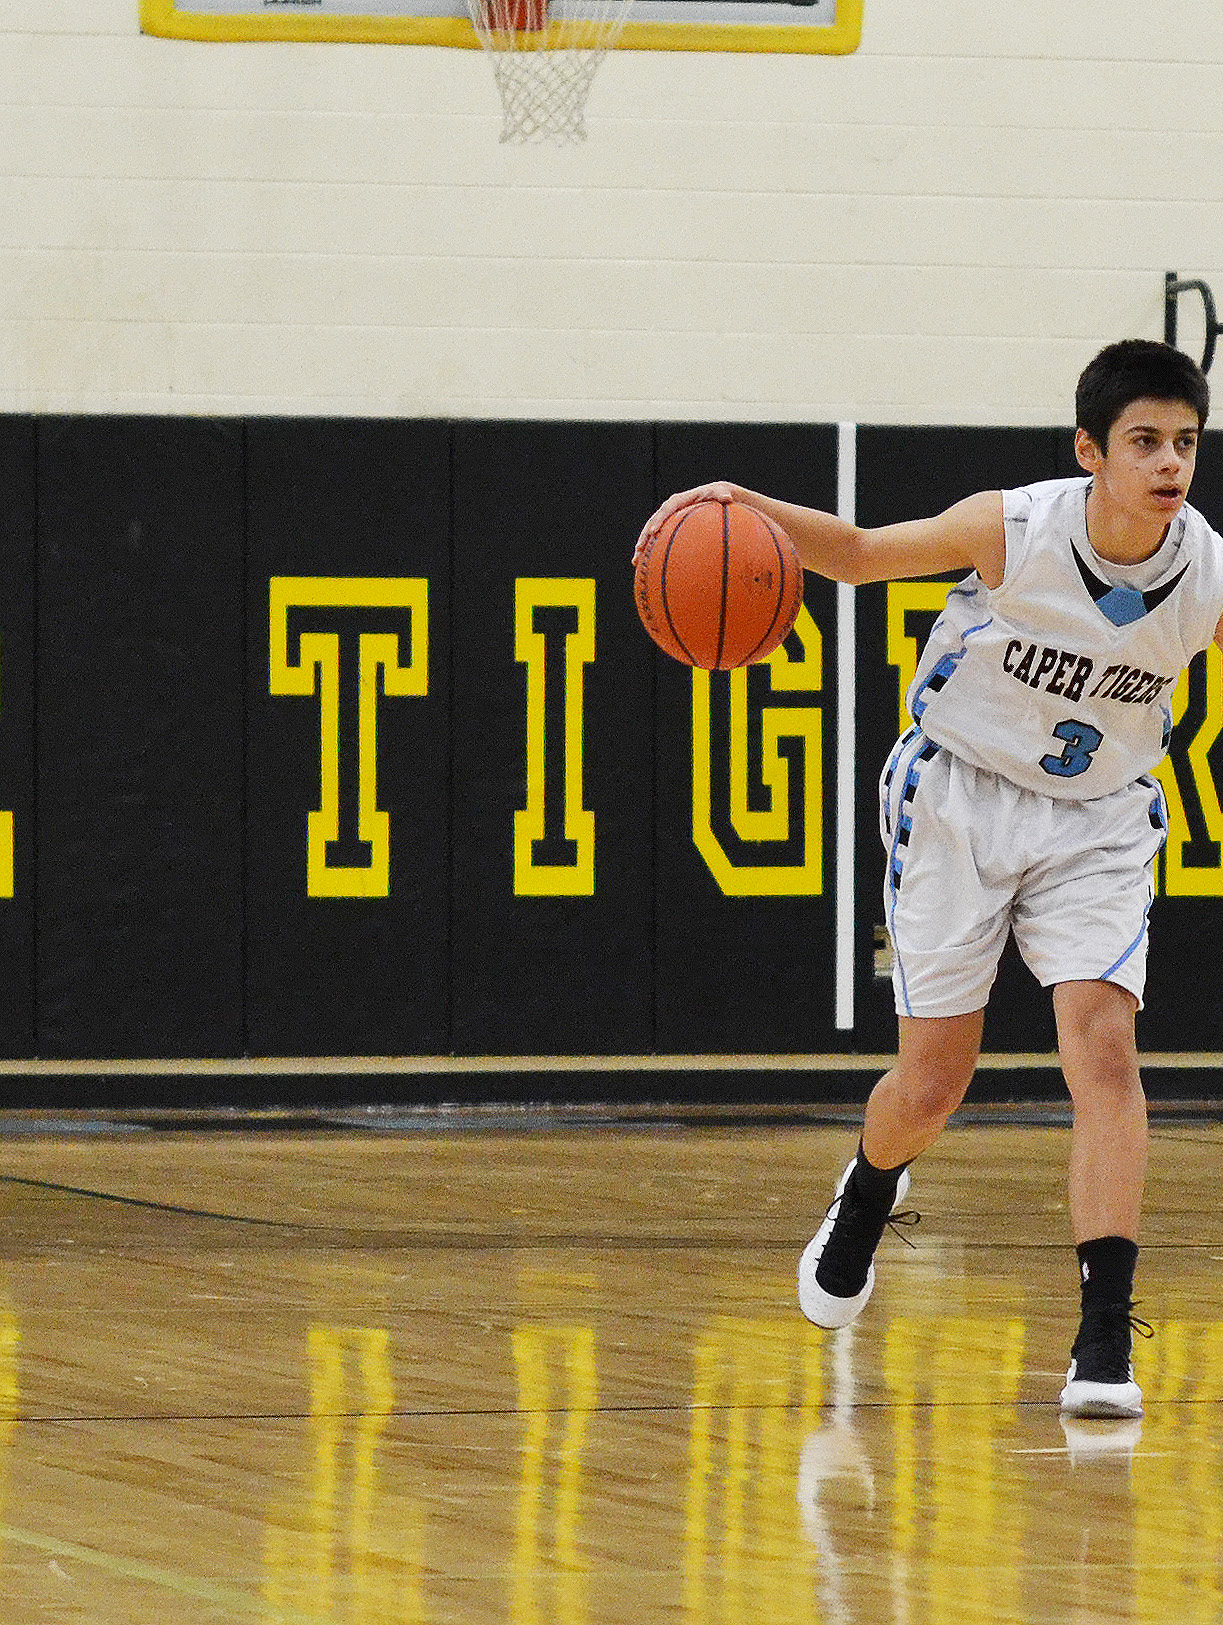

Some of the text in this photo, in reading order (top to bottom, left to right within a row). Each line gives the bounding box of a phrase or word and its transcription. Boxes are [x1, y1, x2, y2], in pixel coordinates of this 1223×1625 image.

[1003, 640, 1175, 704] CAPER TIGERS
[1039, 719, 1104, 777] 3
